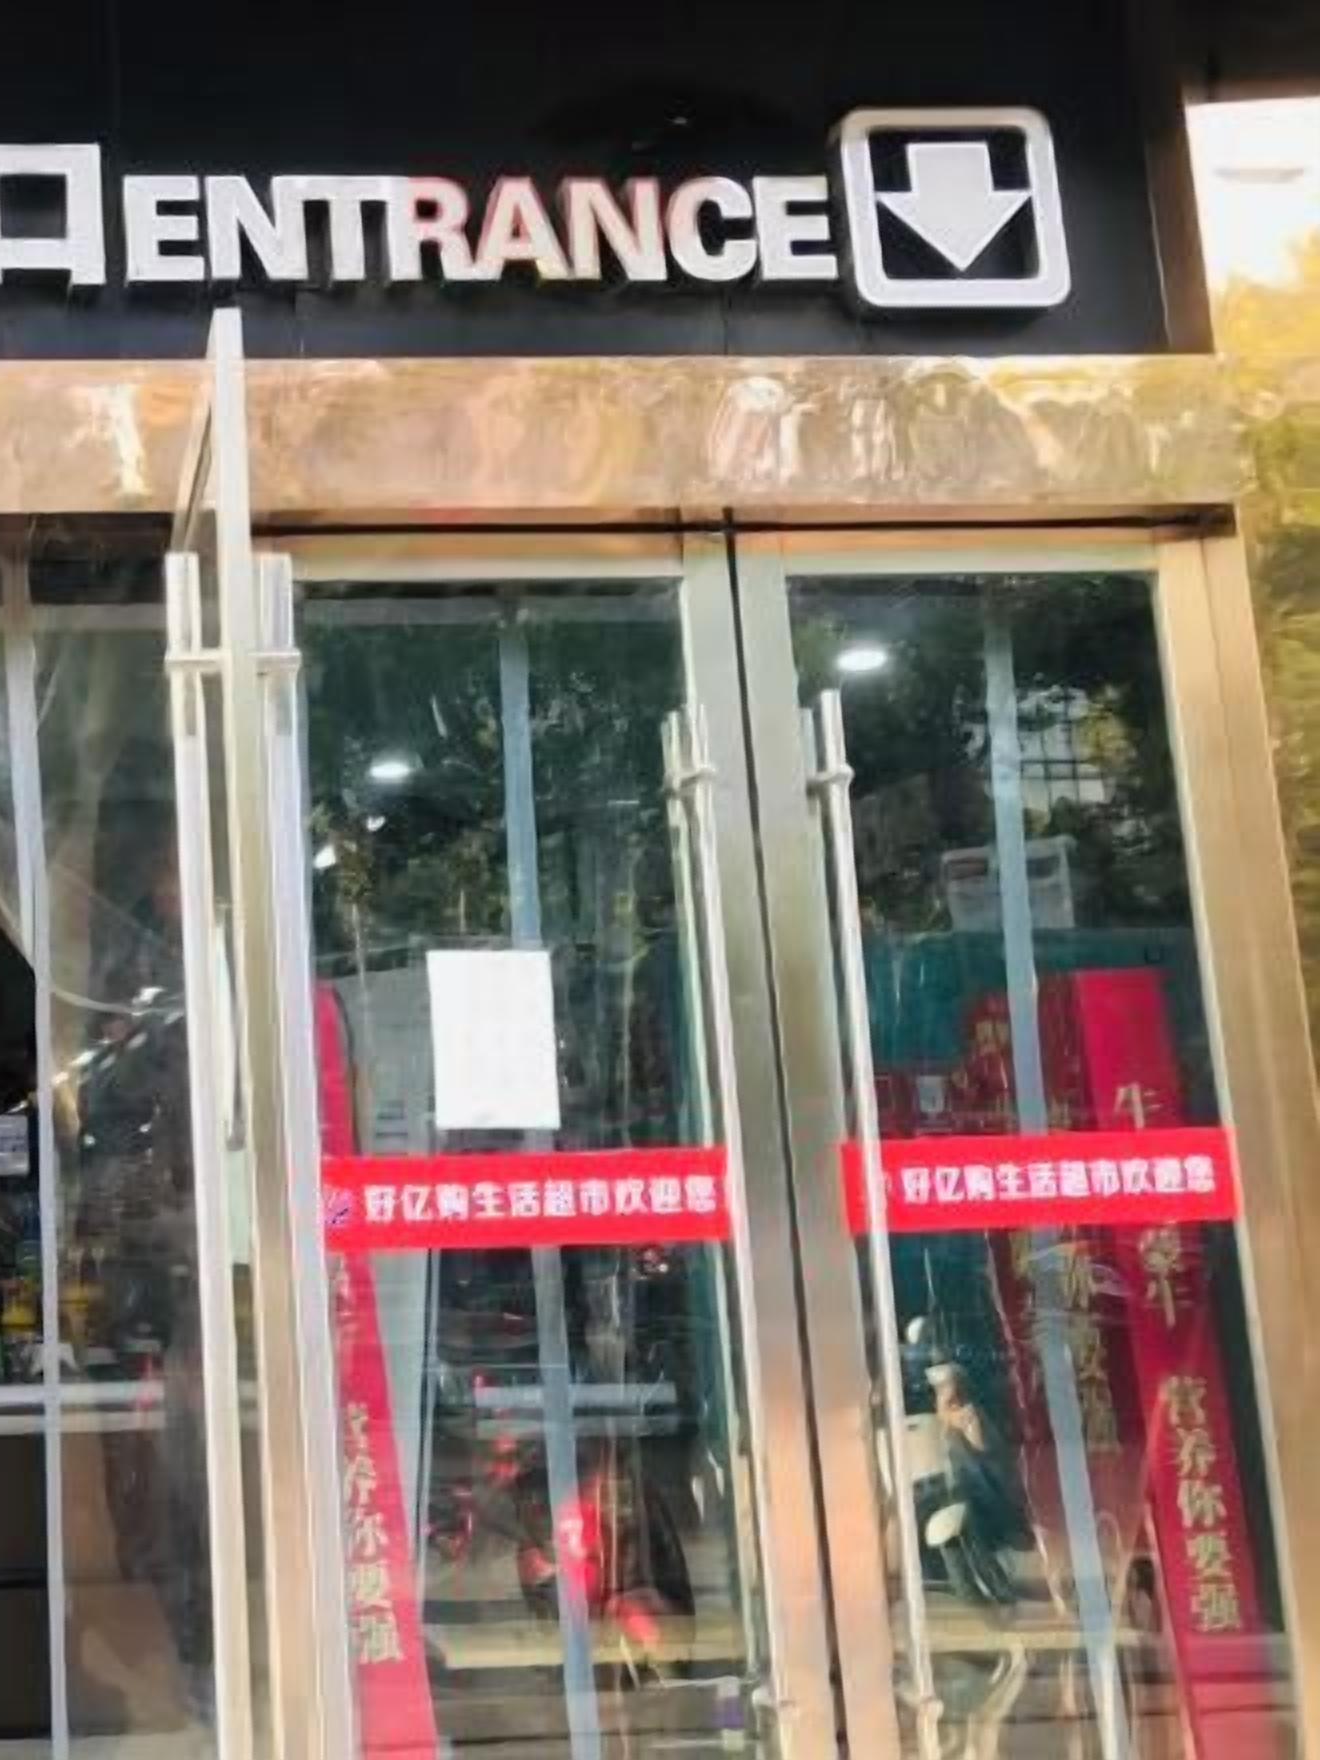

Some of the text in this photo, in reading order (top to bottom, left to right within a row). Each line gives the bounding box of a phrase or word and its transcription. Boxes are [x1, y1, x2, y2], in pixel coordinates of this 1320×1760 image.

[122, 173, 839, 284] ENTRANCE
[363, 1174, 717, 1223] 好亿购生活超市欢迎您
[900, 1154, 1216, 1205] 好亿购生活超市欢迎您
